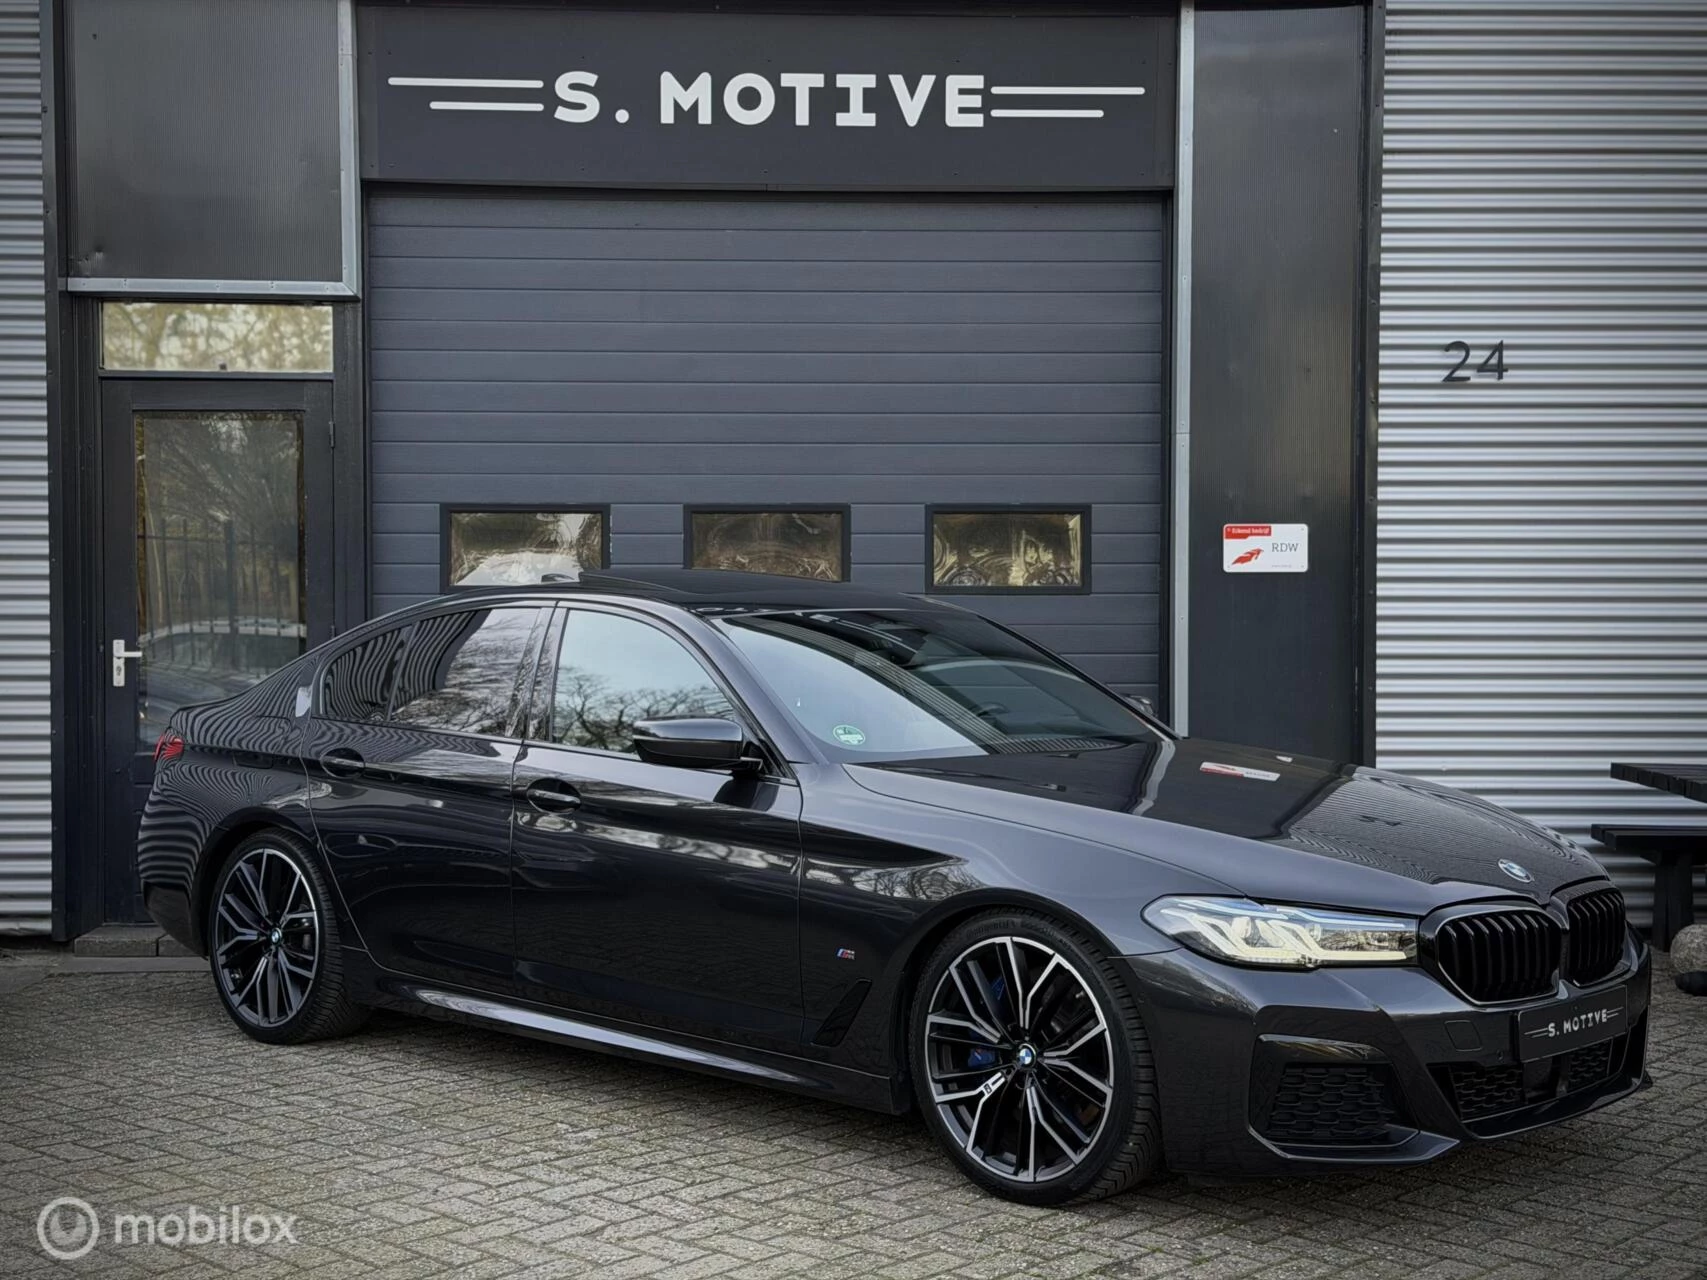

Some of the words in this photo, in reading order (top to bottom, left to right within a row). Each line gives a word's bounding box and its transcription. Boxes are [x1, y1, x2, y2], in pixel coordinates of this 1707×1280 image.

[554, 71, 630, 124] S.
[660, 71, 985, 128] MOTIVE
[1442, 339, 1509, 383] 24
[1271, 542, 1299, 553] RDW
[1548, 1022, 1560, 1037] S.
[1563, 1009, 1607, 1034] MOTIVE
